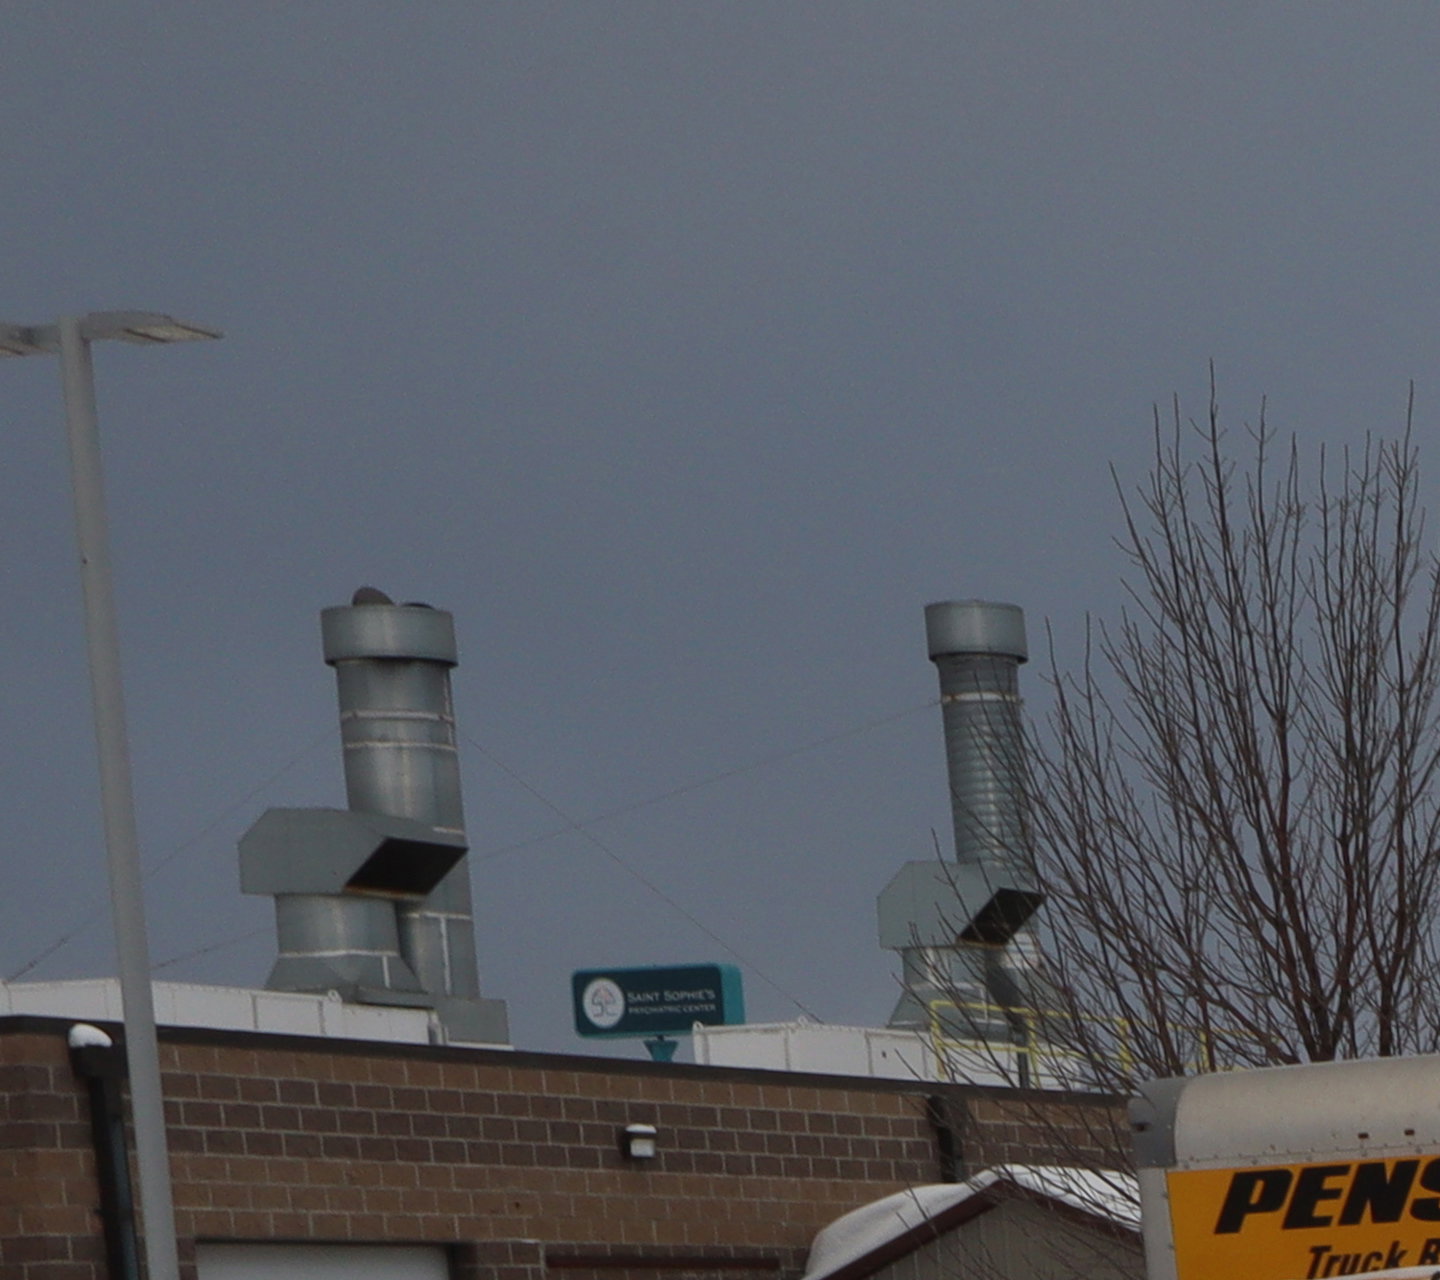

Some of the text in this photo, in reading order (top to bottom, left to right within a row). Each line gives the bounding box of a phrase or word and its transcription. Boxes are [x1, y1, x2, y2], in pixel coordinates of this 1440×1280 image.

[627, 991, 660, 1003] SAINT
[683, 1002, 716, 1013] CENTER
[1306, 1239, 1408, 1280] Truck
